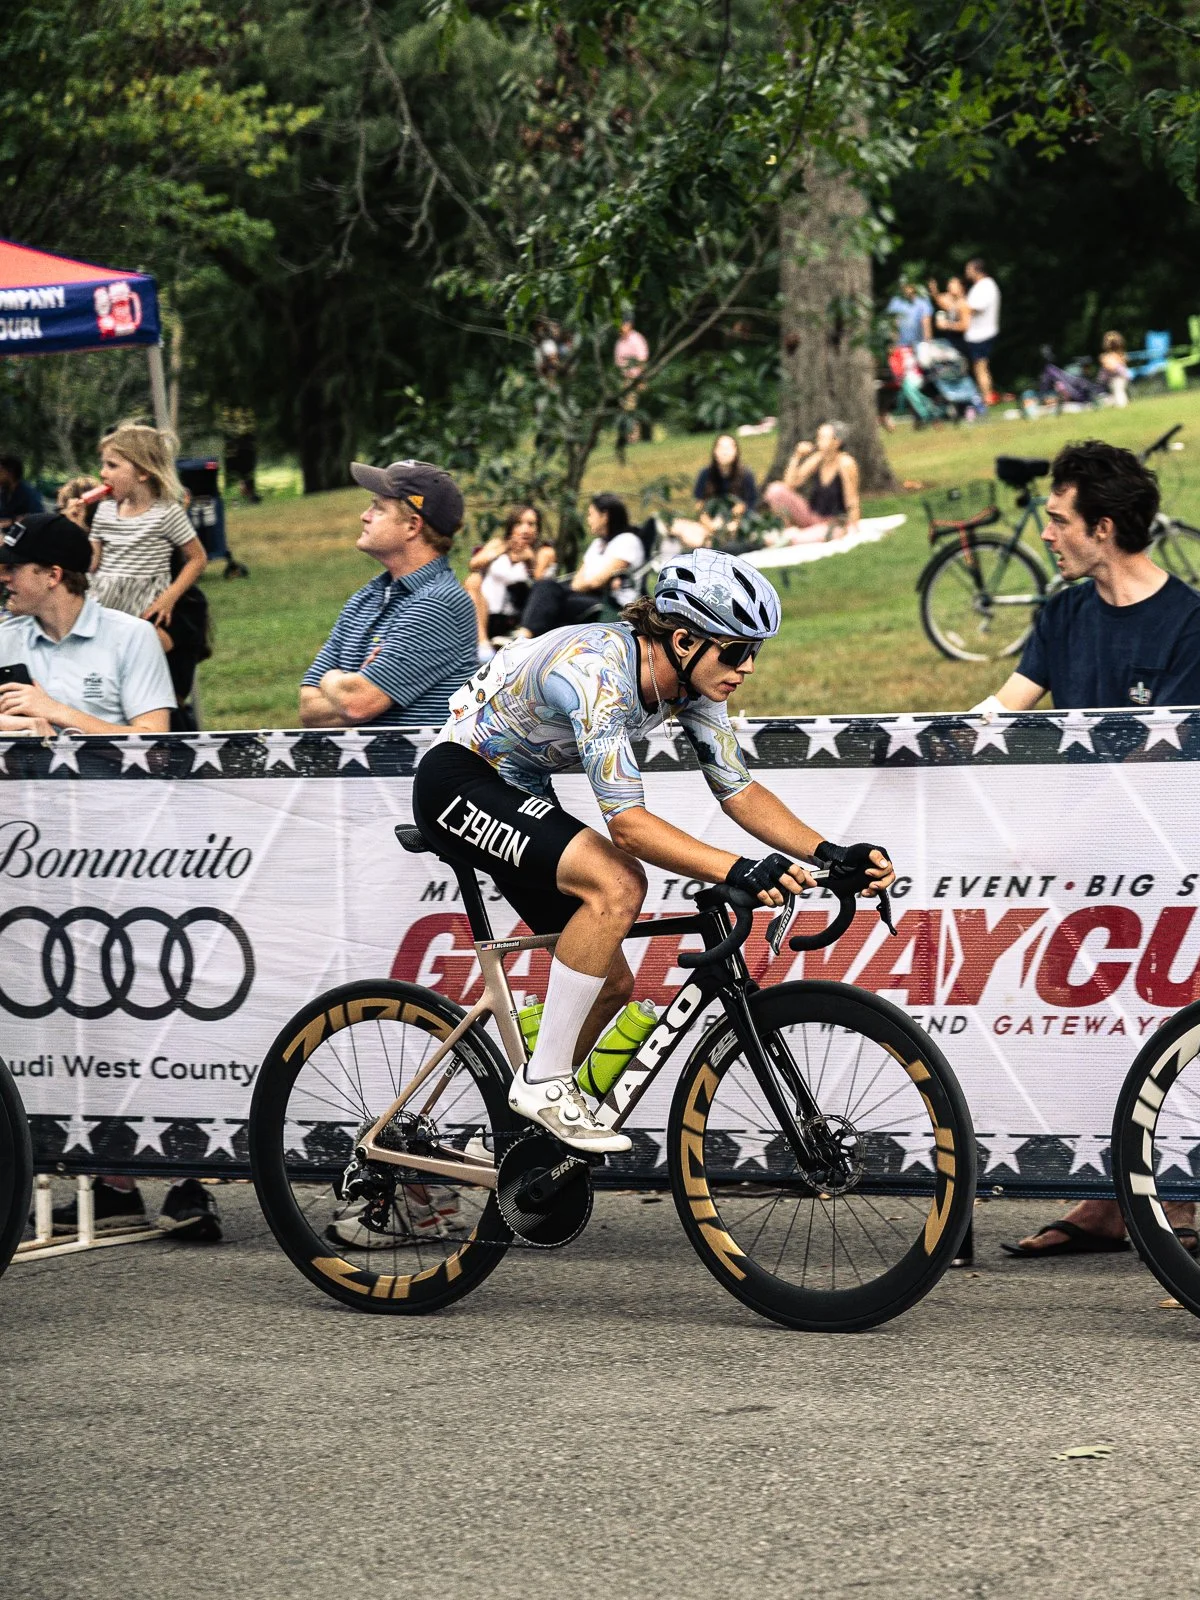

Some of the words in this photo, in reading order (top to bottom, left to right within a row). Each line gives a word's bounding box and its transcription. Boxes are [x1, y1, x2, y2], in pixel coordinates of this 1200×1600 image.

[0, 287, 64, 311] MPANY
[0, 820, 253, 879] Bommarito
[933, 875, 1057, 898] EVENT
[1085, 874, 1155, 897] BIG
[9, 1055, 53, 1077] udi
[62, 1055, 141, 1078] West
[150, 1056, 258, 1087] County
